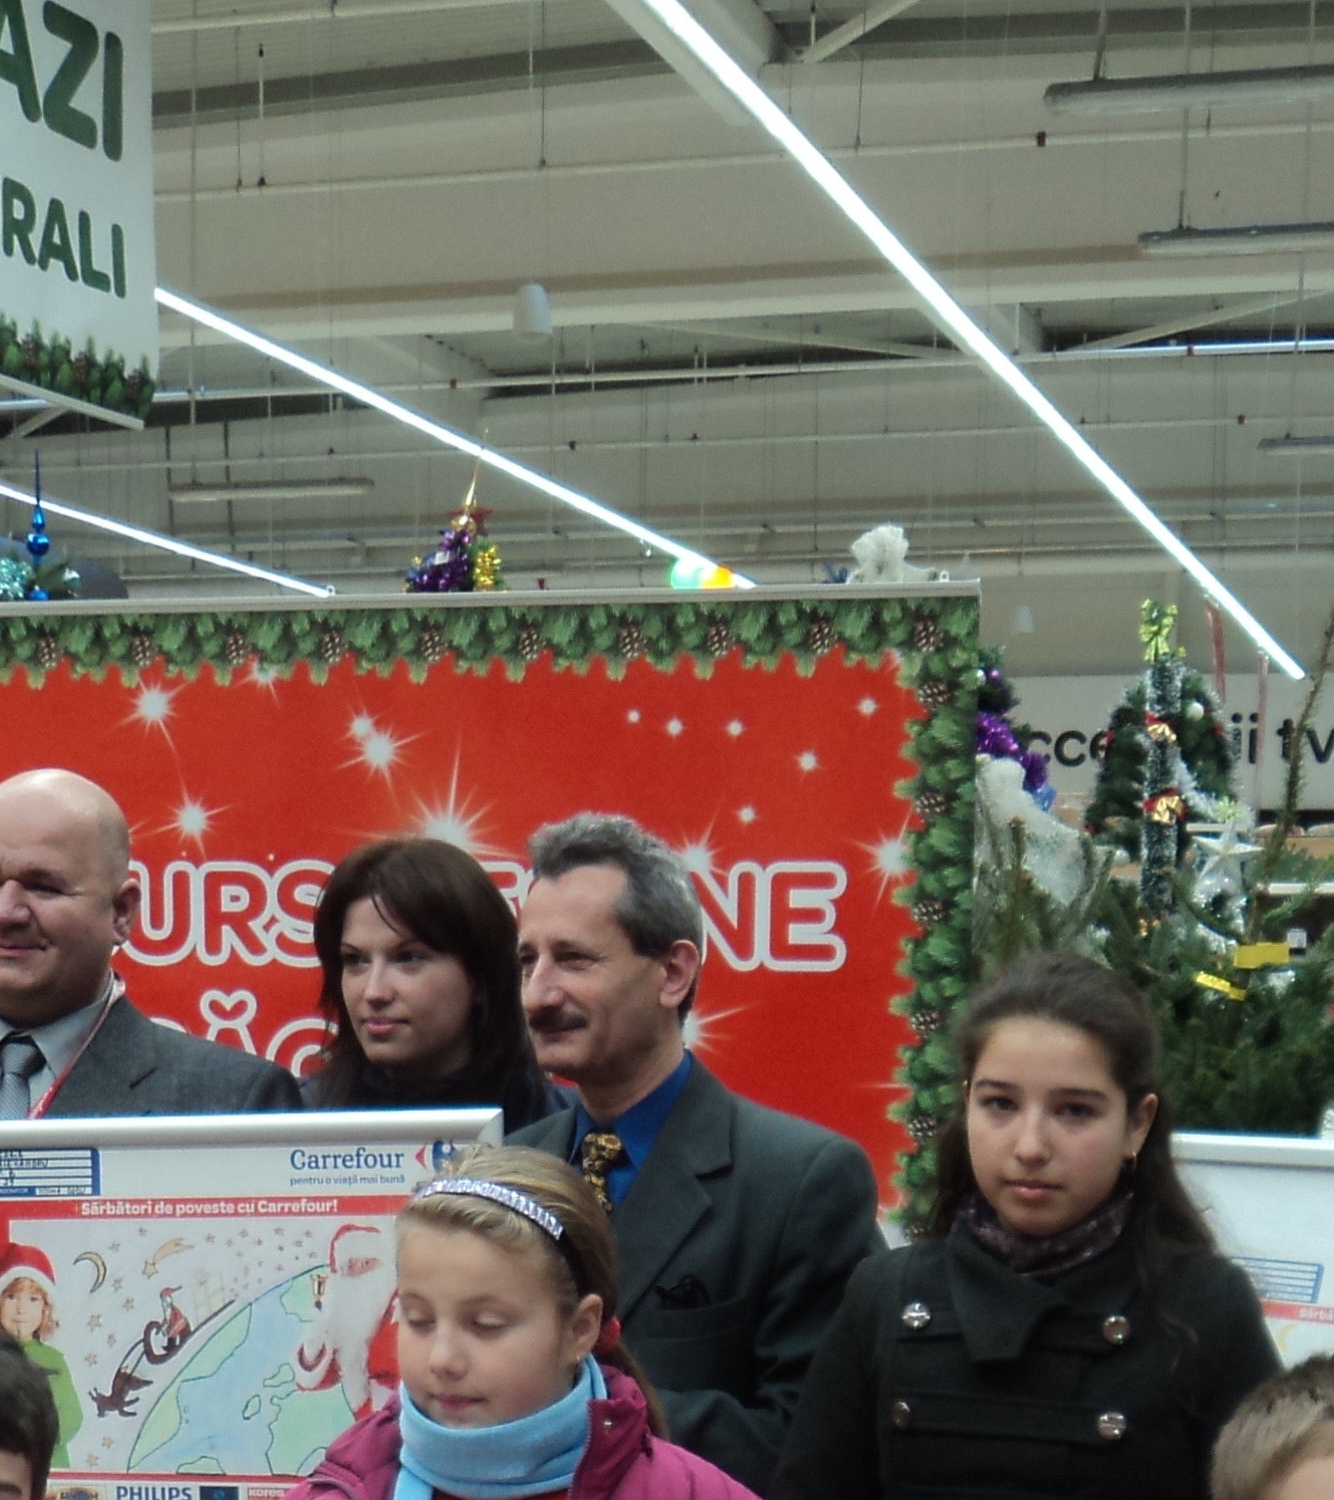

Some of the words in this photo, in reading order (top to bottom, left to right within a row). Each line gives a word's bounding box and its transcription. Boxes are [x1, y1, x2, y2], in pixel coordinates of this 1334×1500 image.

[290, 1147, 404, 1170] Carrefour
[290, 1176, 323, 1187] pentru
[360, 1175, 378, 1184] mai
[380, 1174, 405, 1184] bună
[81, 1201, 152, 1216] Sărbători
[154, 1201, 173, 1215] de
[176, 1203, 235, 1217] poveste
[237, 1203, 255, 1214] cu
[257, 1199, 338, 1214] Carrefour!
